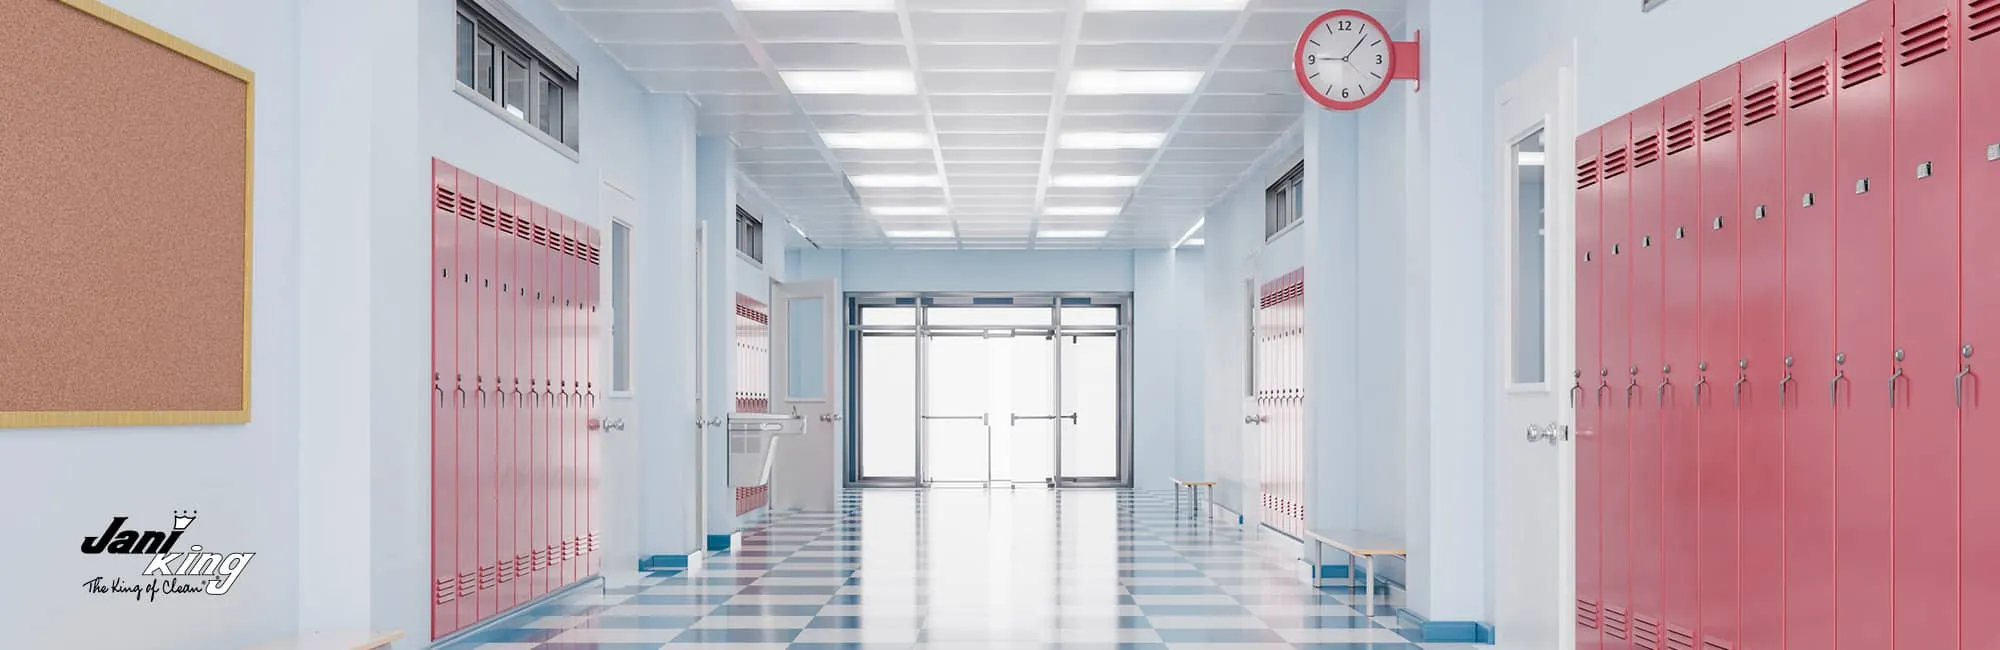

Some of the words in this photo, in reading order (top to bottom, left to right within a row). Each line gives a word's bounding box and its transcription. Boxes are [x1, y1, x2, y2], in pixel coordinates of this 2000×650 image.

[1338, 21, 1352, 31] 12
[1308, 54, 1316, 65] 9
[1376, 54, 1383, 65] 3
[1341, 88, 1349, 98] 6
